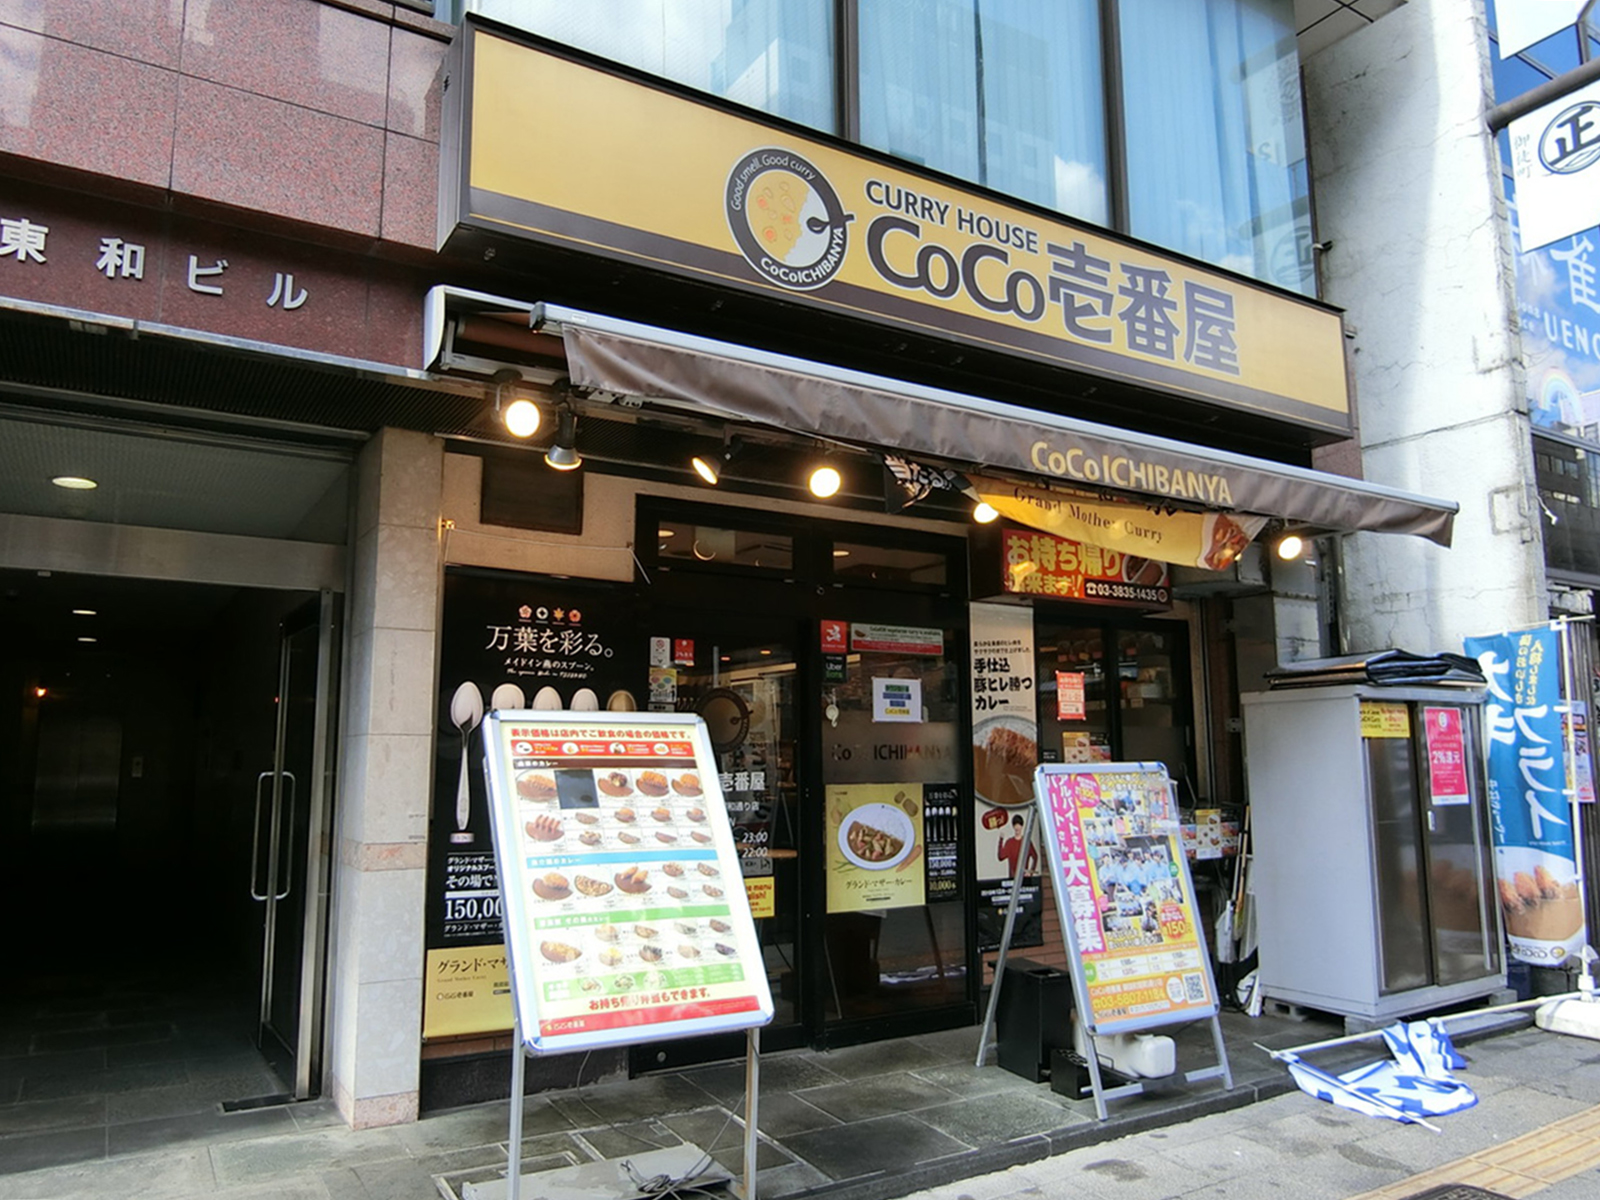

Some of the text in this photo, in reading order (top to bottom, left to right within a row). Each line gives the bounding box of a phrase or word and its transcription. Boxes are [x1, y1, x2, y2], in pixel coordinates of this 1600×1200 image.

[731, 178, 745, 211] Good
[762, 154, 789, 167] Good
[790, 160, 816, 181] curry
[865, 179, 1039, 254] CURRY HOUSE
[0, 218, 308, 310] 東和ビル
[760, 227, 844, 283] CoCoICHIBANYA
[866, 215, 1241, 376] CoCo壱番屋
[1031, 441, 1233, 504] CoCoICHIBANYA
[1013, 487, 1061, 514] Grand
[1124, 518, 1163, 544] Curry
[1007, 535, 1121, 577] お持ち帰り
[485, 625, 614, 658] 万葉を彩る。
[826, 662, 842, 670] Uber
[974, 658, 1010, 673] 手仕込
[975, 695, 1009, 711] カレー
[1056, 775, 1082, 852] アルバイトさん
[446, 874, 498, 889] その場で
[1062, 853, 1103, 952] 大募集
